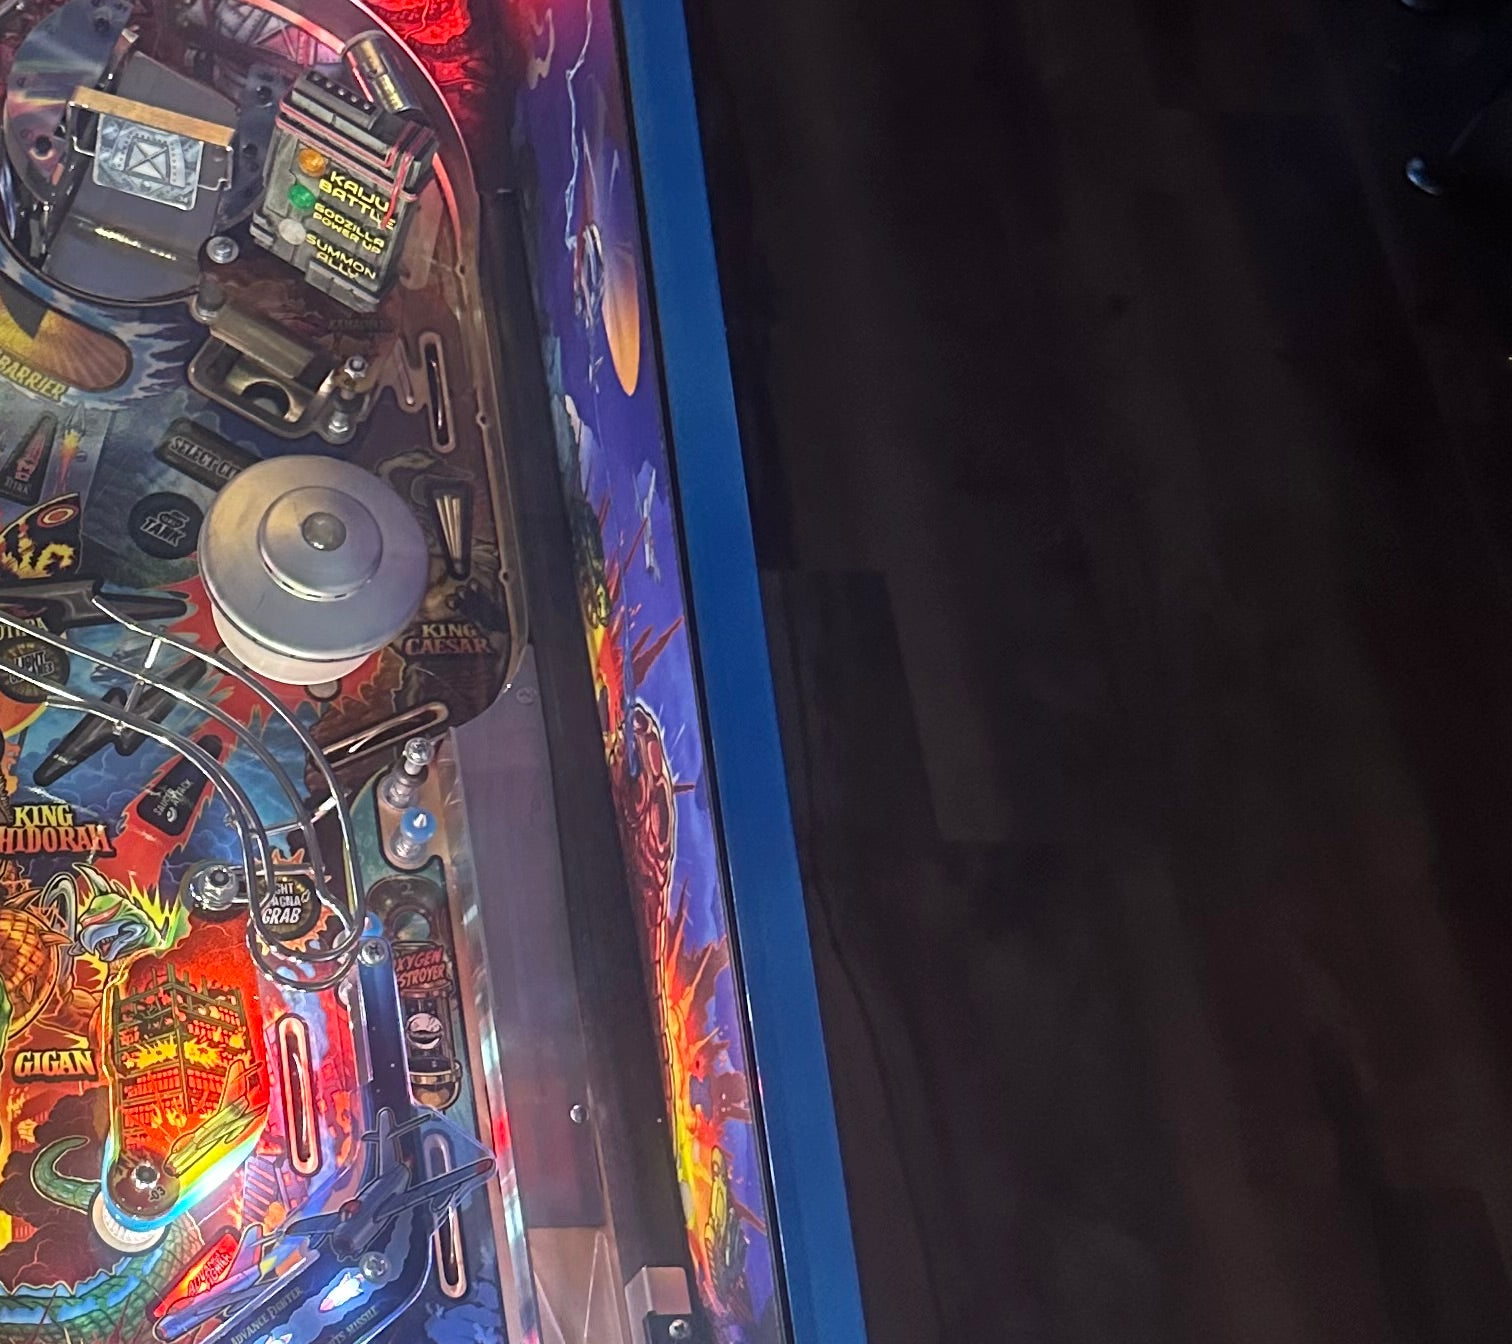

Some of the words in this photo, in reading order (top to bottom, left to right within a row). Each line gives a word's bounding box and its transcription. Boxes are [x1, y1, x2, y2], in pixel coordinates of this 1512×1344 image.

[318, 178, 396, 231] BATTLE
[330, 170, 391, 212] KAIJU
[312, 211, 360, 244] POWER
[362, 239, 383, 255] UP
[313, 202, 385, 248] GODZILLA
[305, 233, 377, 279] SUMMON
[316, 251, 360, 279] ALLY
[169, 436, 221, 471] SELECT
[140, 516, 186, 548] TANK
[405, 637, 490, 655] CAESAR
[421, 623, 477, 639] KING
[14, 803, 73, 827] KING
[261, 907, 301, 925] GRAB
[399, 965, 447, 990] STROYER
[15, 1049, 95, 1077] GIGAN
[268, 1284, 305, 1320] FIGHTER
[344, 1305, 380, 1337] MISSILE
